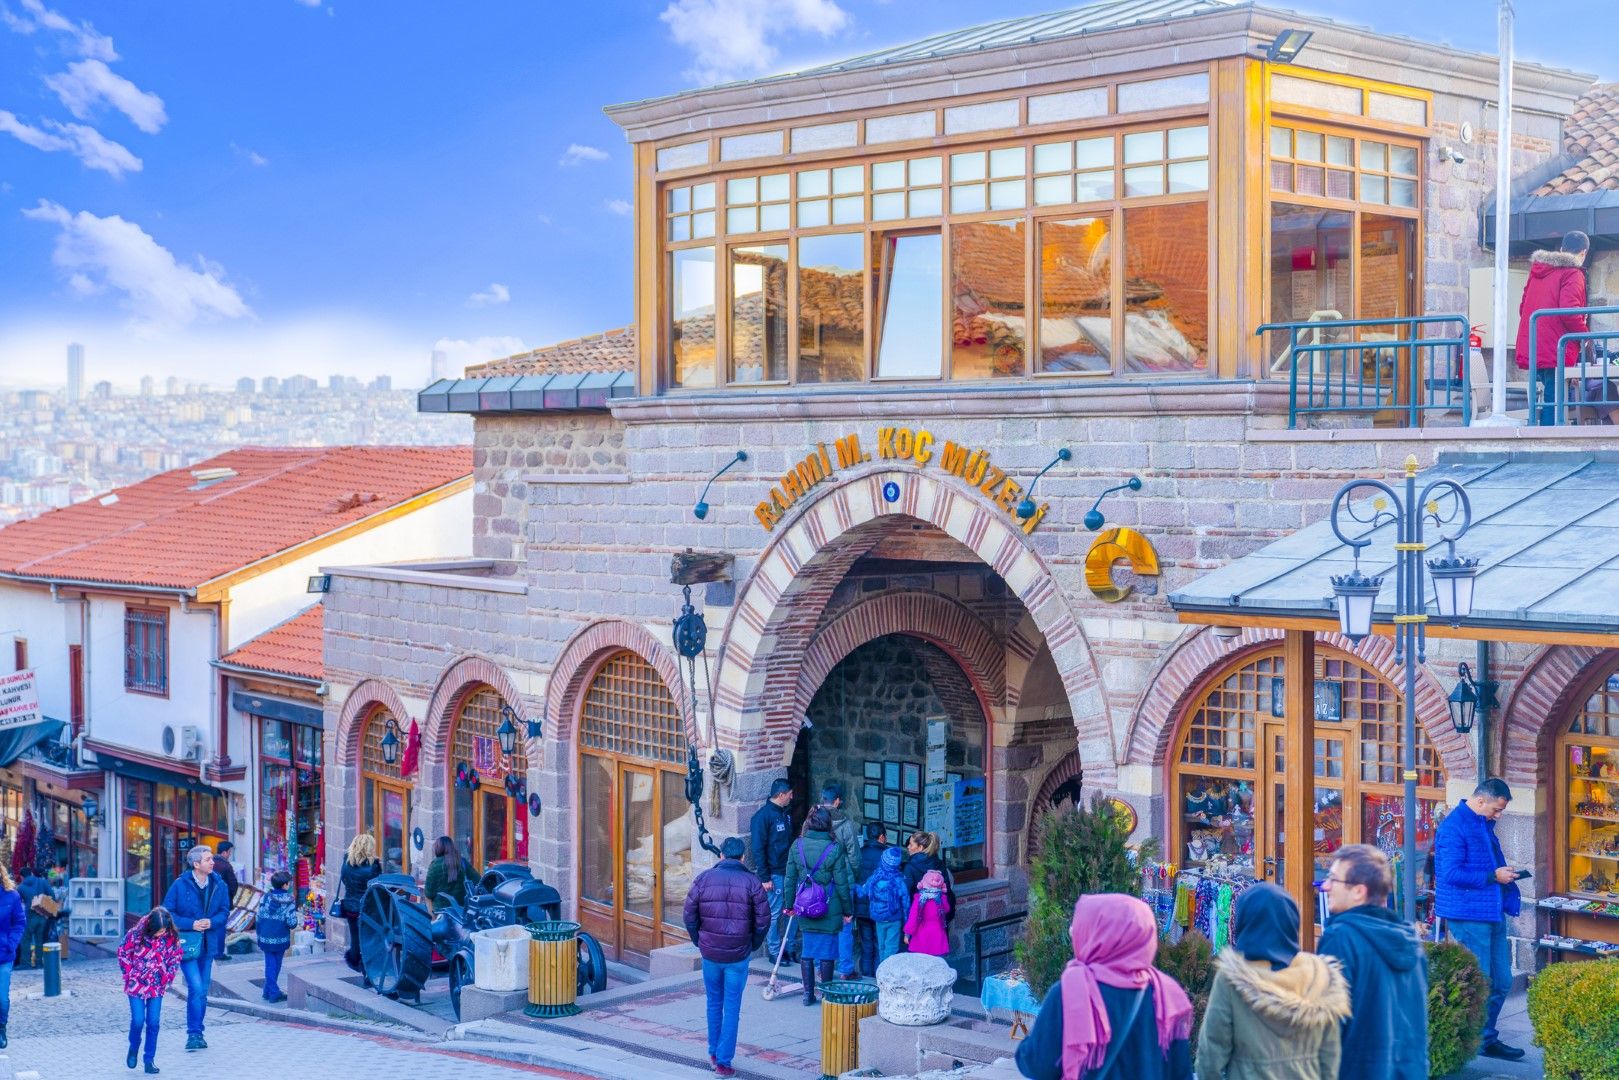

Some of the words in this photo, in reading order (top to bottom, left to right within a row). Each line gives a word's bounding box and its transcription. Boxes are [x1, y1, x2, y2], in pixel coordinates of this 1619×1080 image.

[754, 441, 833, 532] RAHMİ
[834, 433, 872, 470] M.
[877, 426, 935, 470] KOÇ
[0, 696, 21, 706] LUNUR
